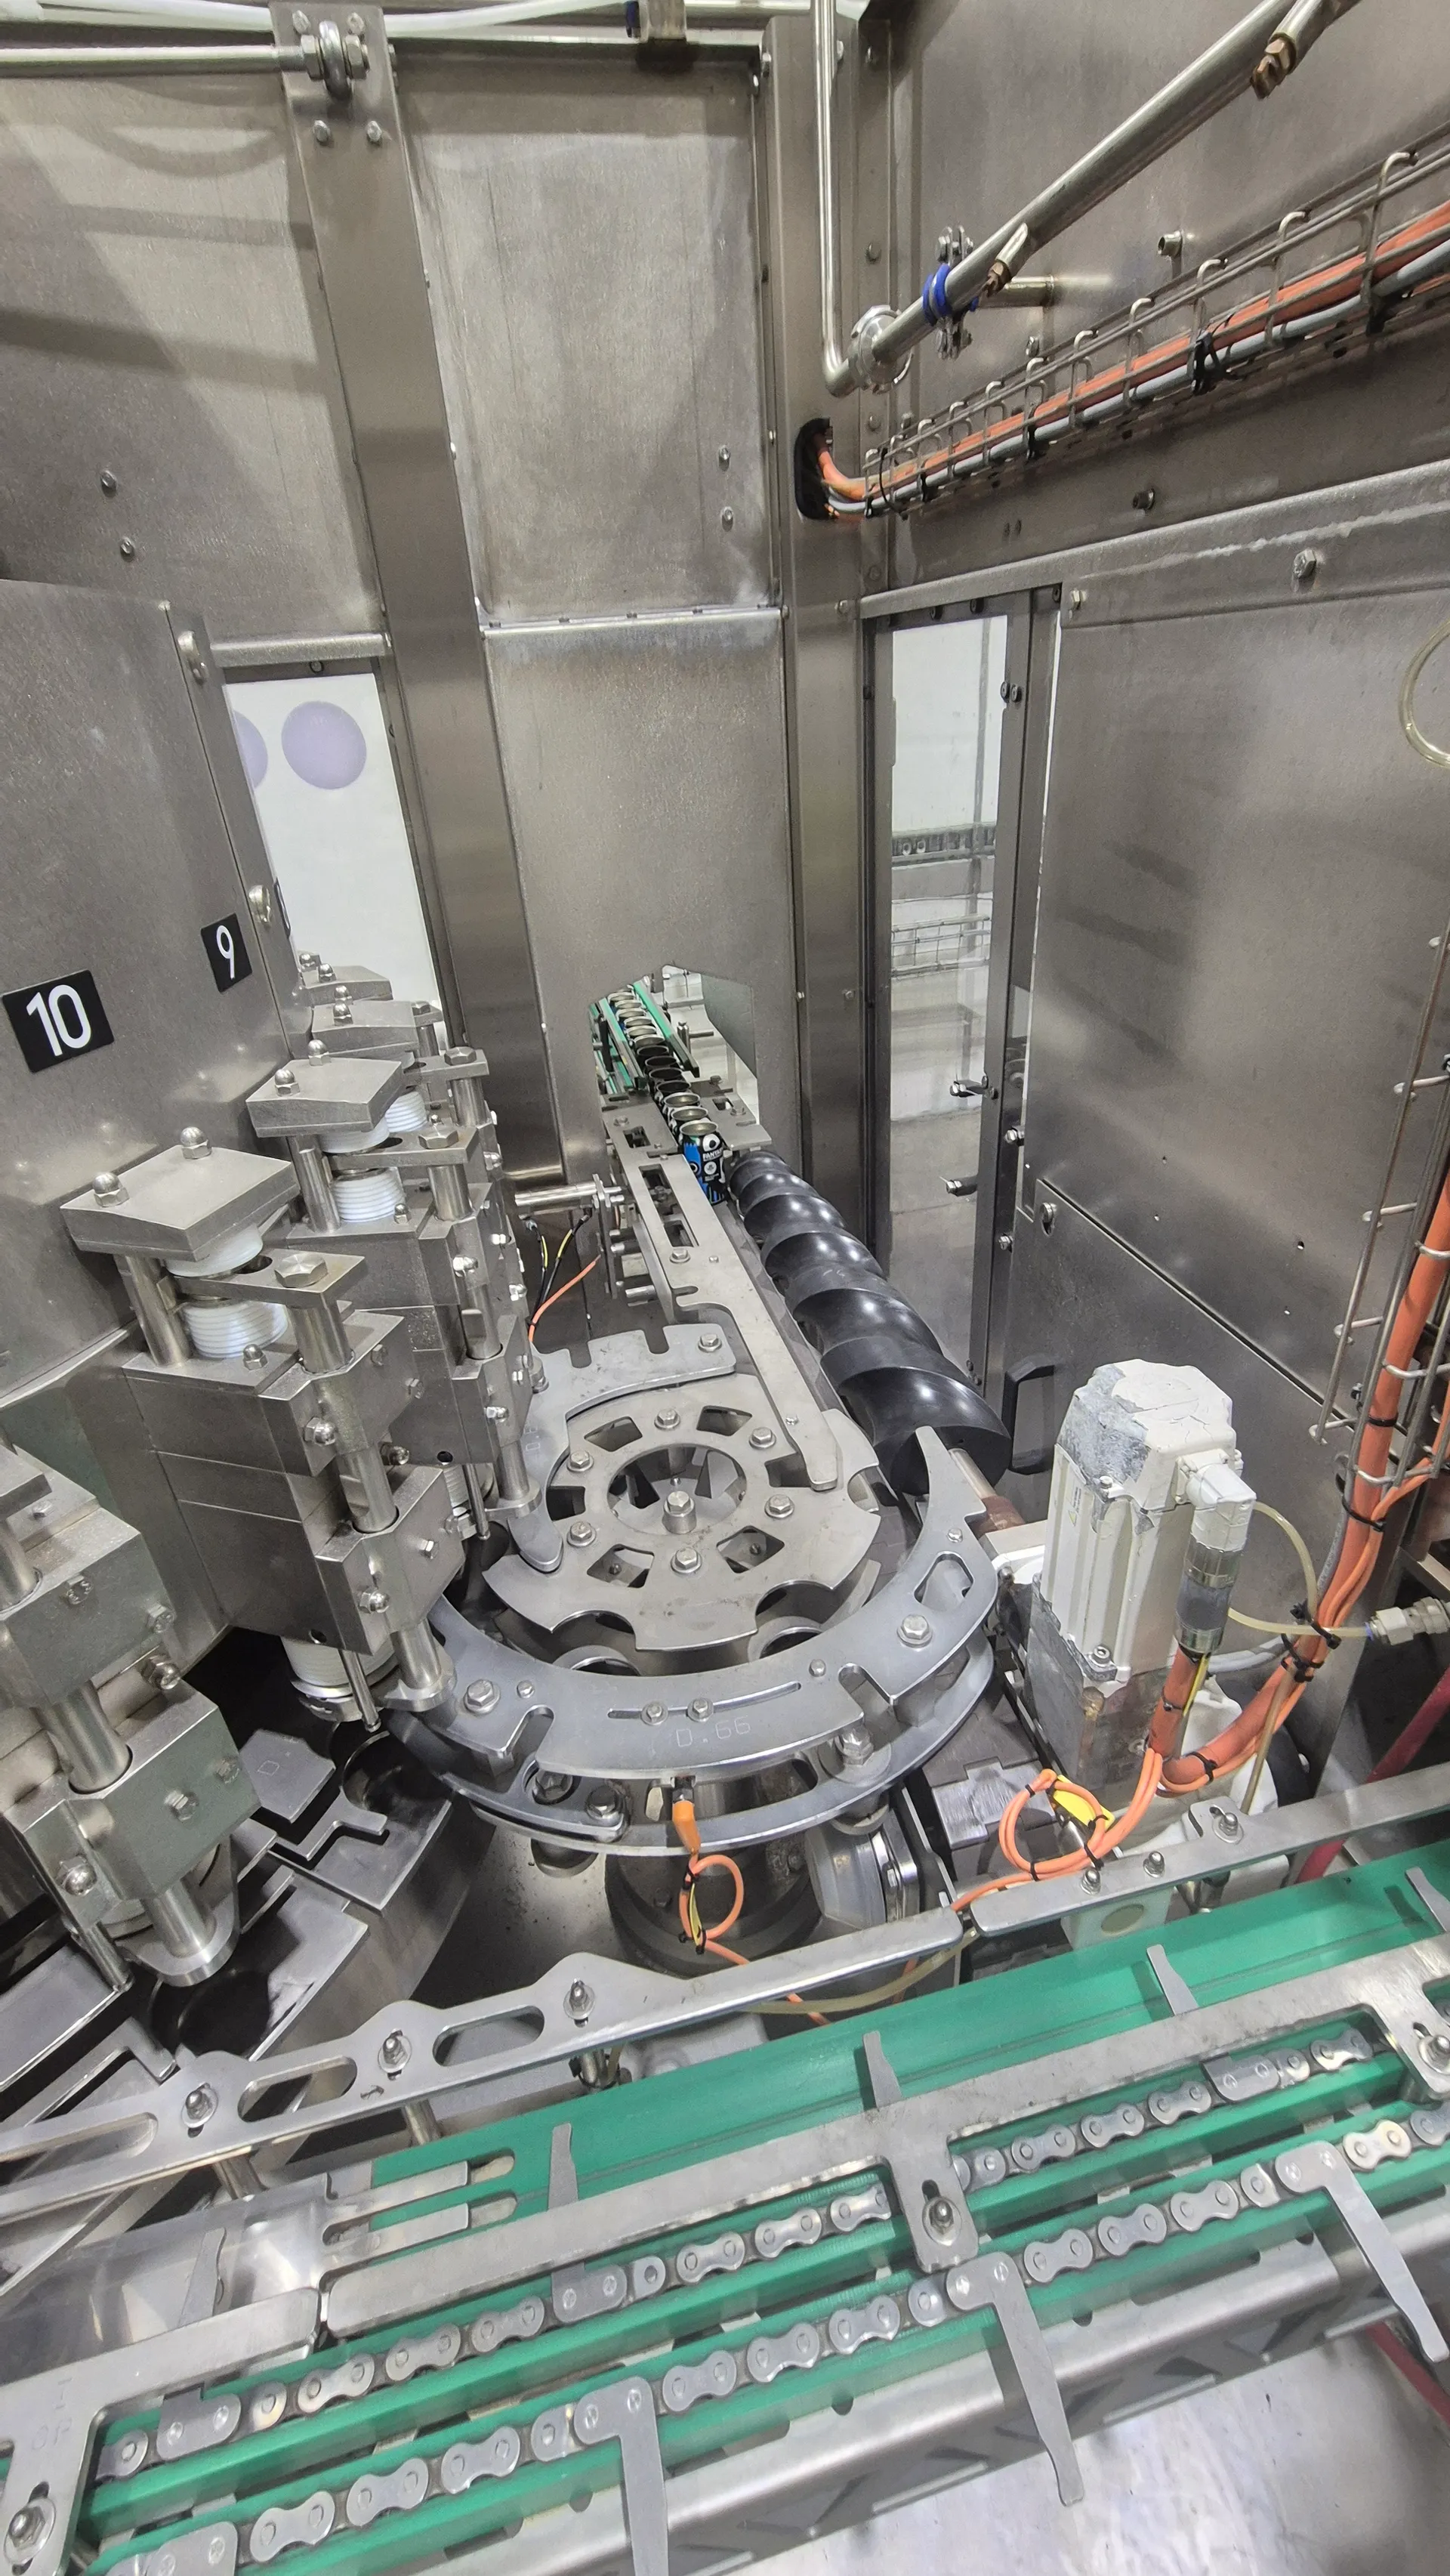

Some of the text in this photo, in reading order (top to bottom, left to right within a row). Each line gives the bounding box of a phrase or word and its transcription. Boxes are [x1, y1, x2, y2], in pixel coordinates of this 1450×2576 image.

[216, 925, 235, 980] 9
[26, 984, 91, 1057] 10
[676, 1715, 751, 1747] D.66
